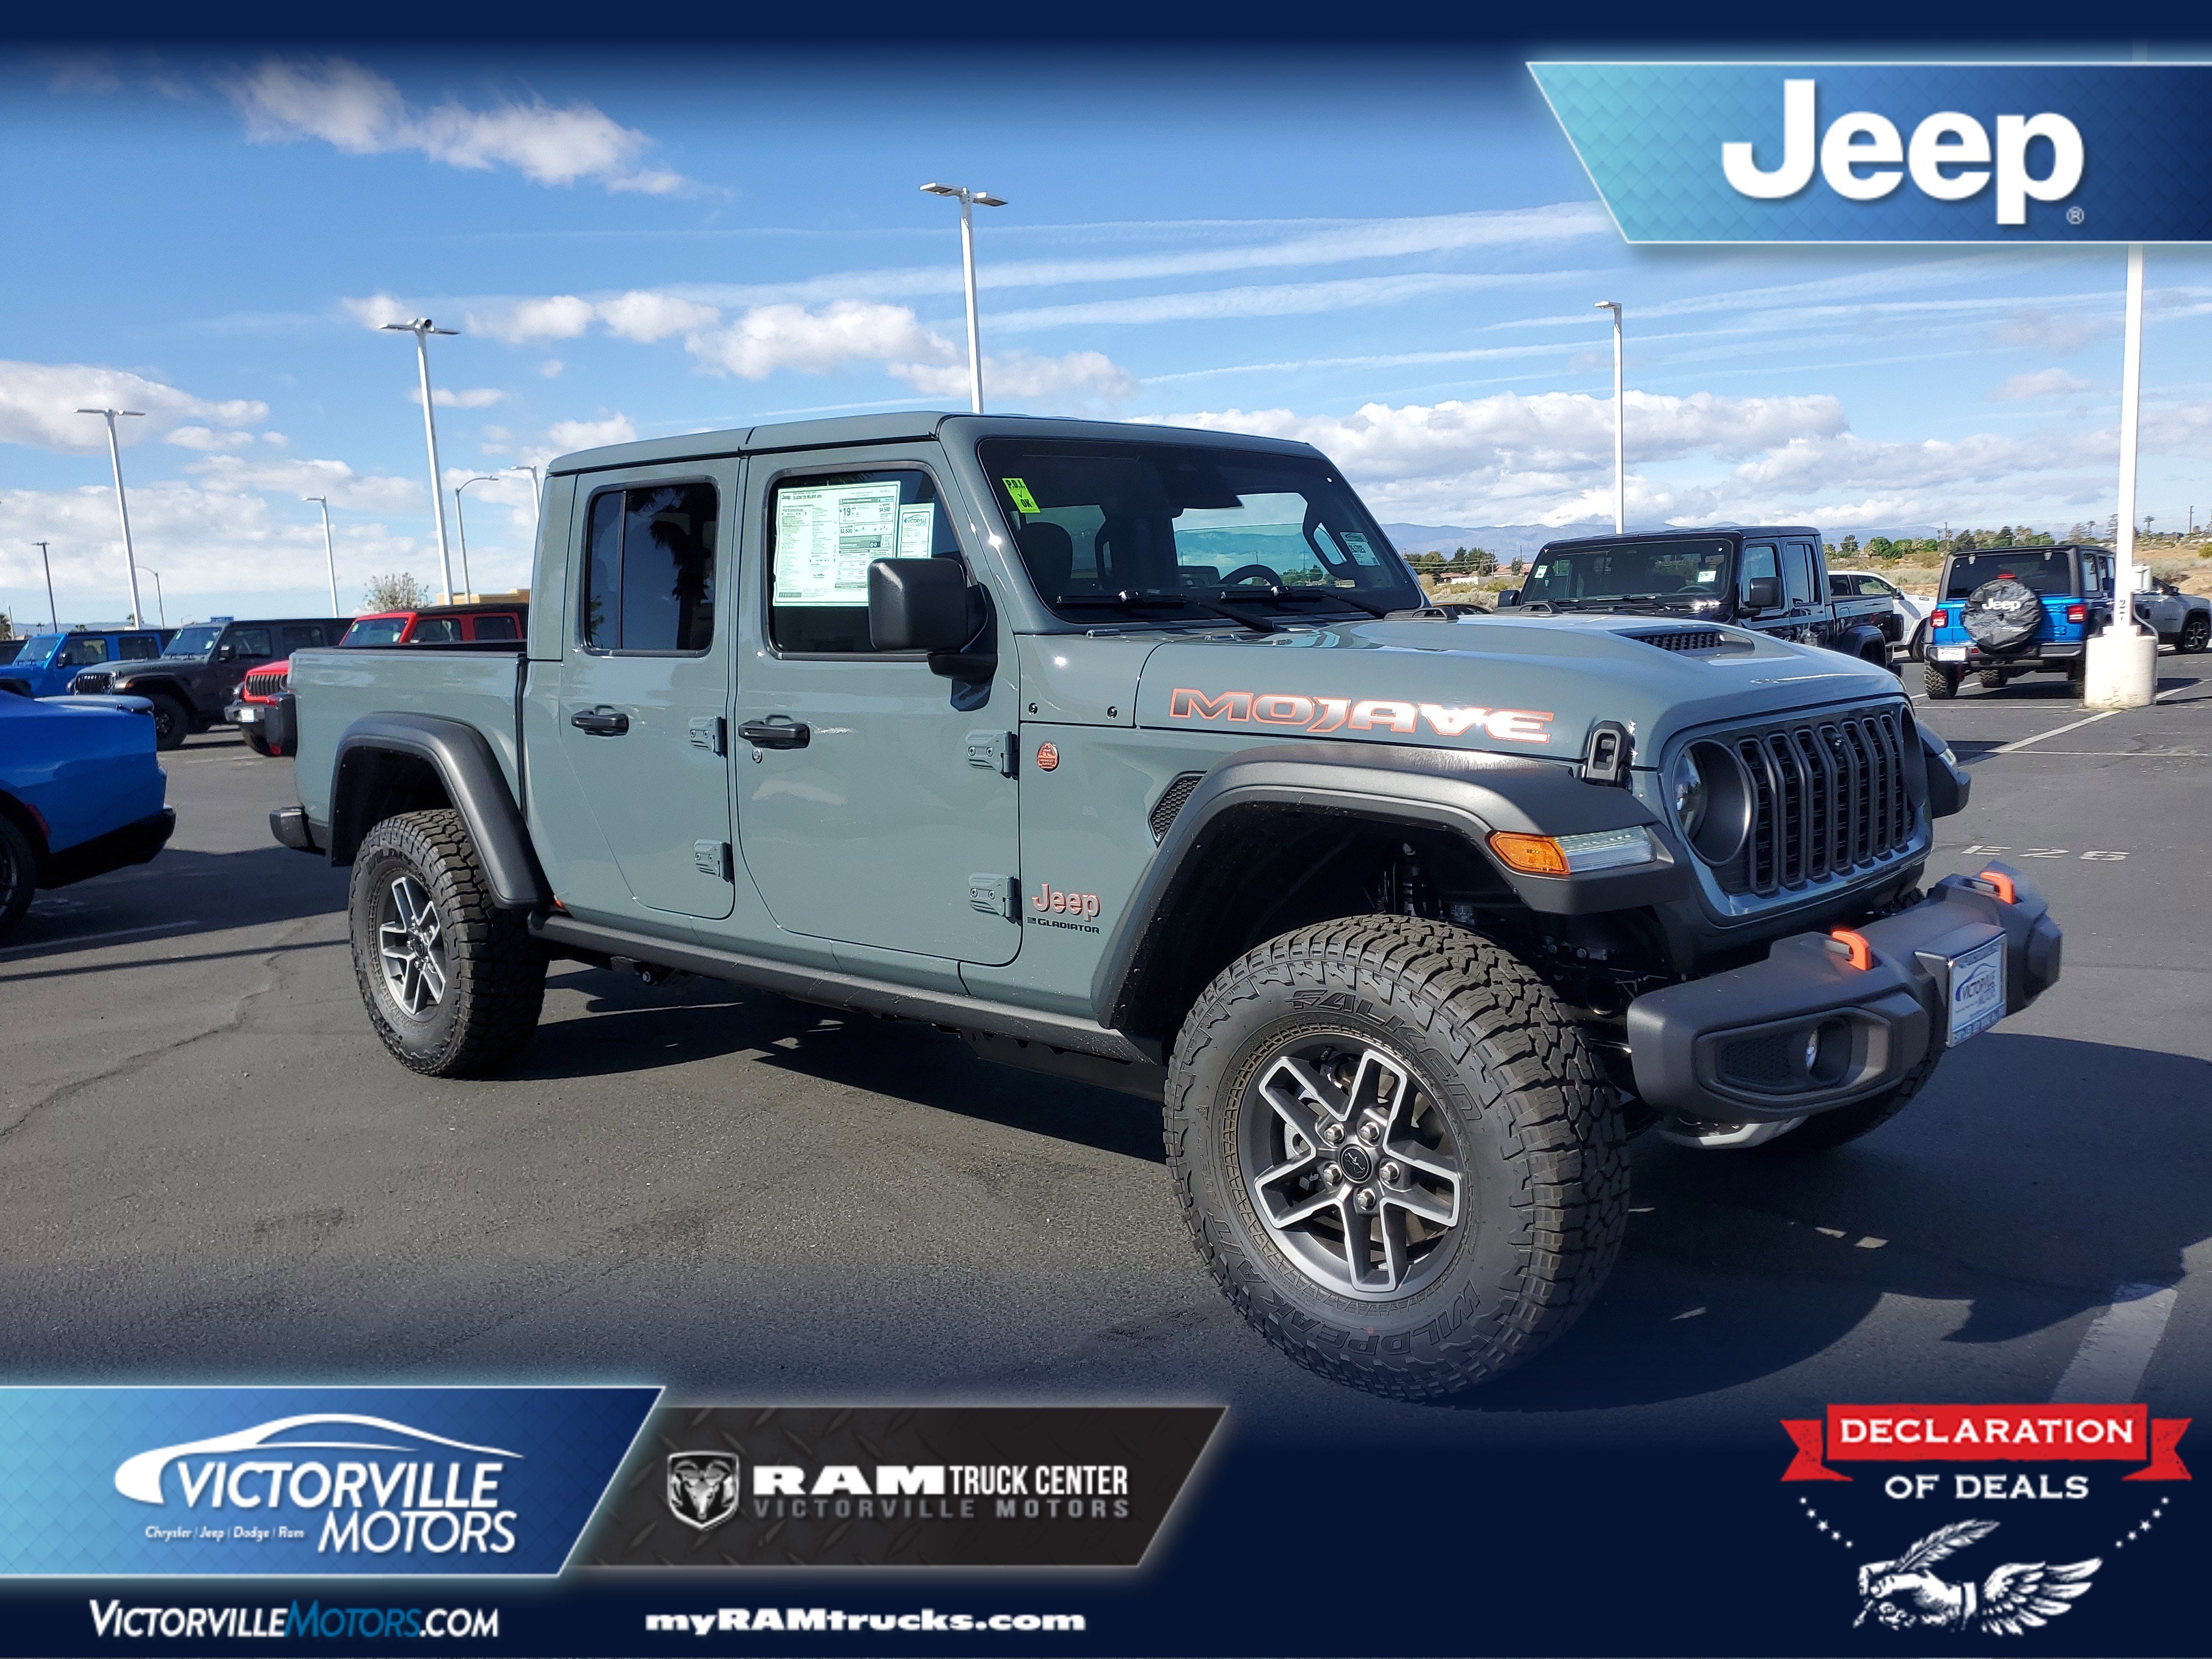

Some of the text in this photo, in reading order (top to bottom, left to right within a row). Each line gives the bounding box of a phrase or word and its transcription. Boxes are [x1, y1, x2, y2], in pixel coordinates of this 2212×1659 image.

[1005, 479, 1025, 489] P.D.I.
[843, 507, 851, 516] 19
[1020, 499, 1033, 508] OK
[1981, 597, 2022, 612] Jeep
[1169, 688, 1555, 744] MOJAVE
[1031, 883, 1101, 923] Jeep
[1037, 917, 1101, 934] GLADIATOR
[1260, 1278, 1481, 1356] WILDPEAK
